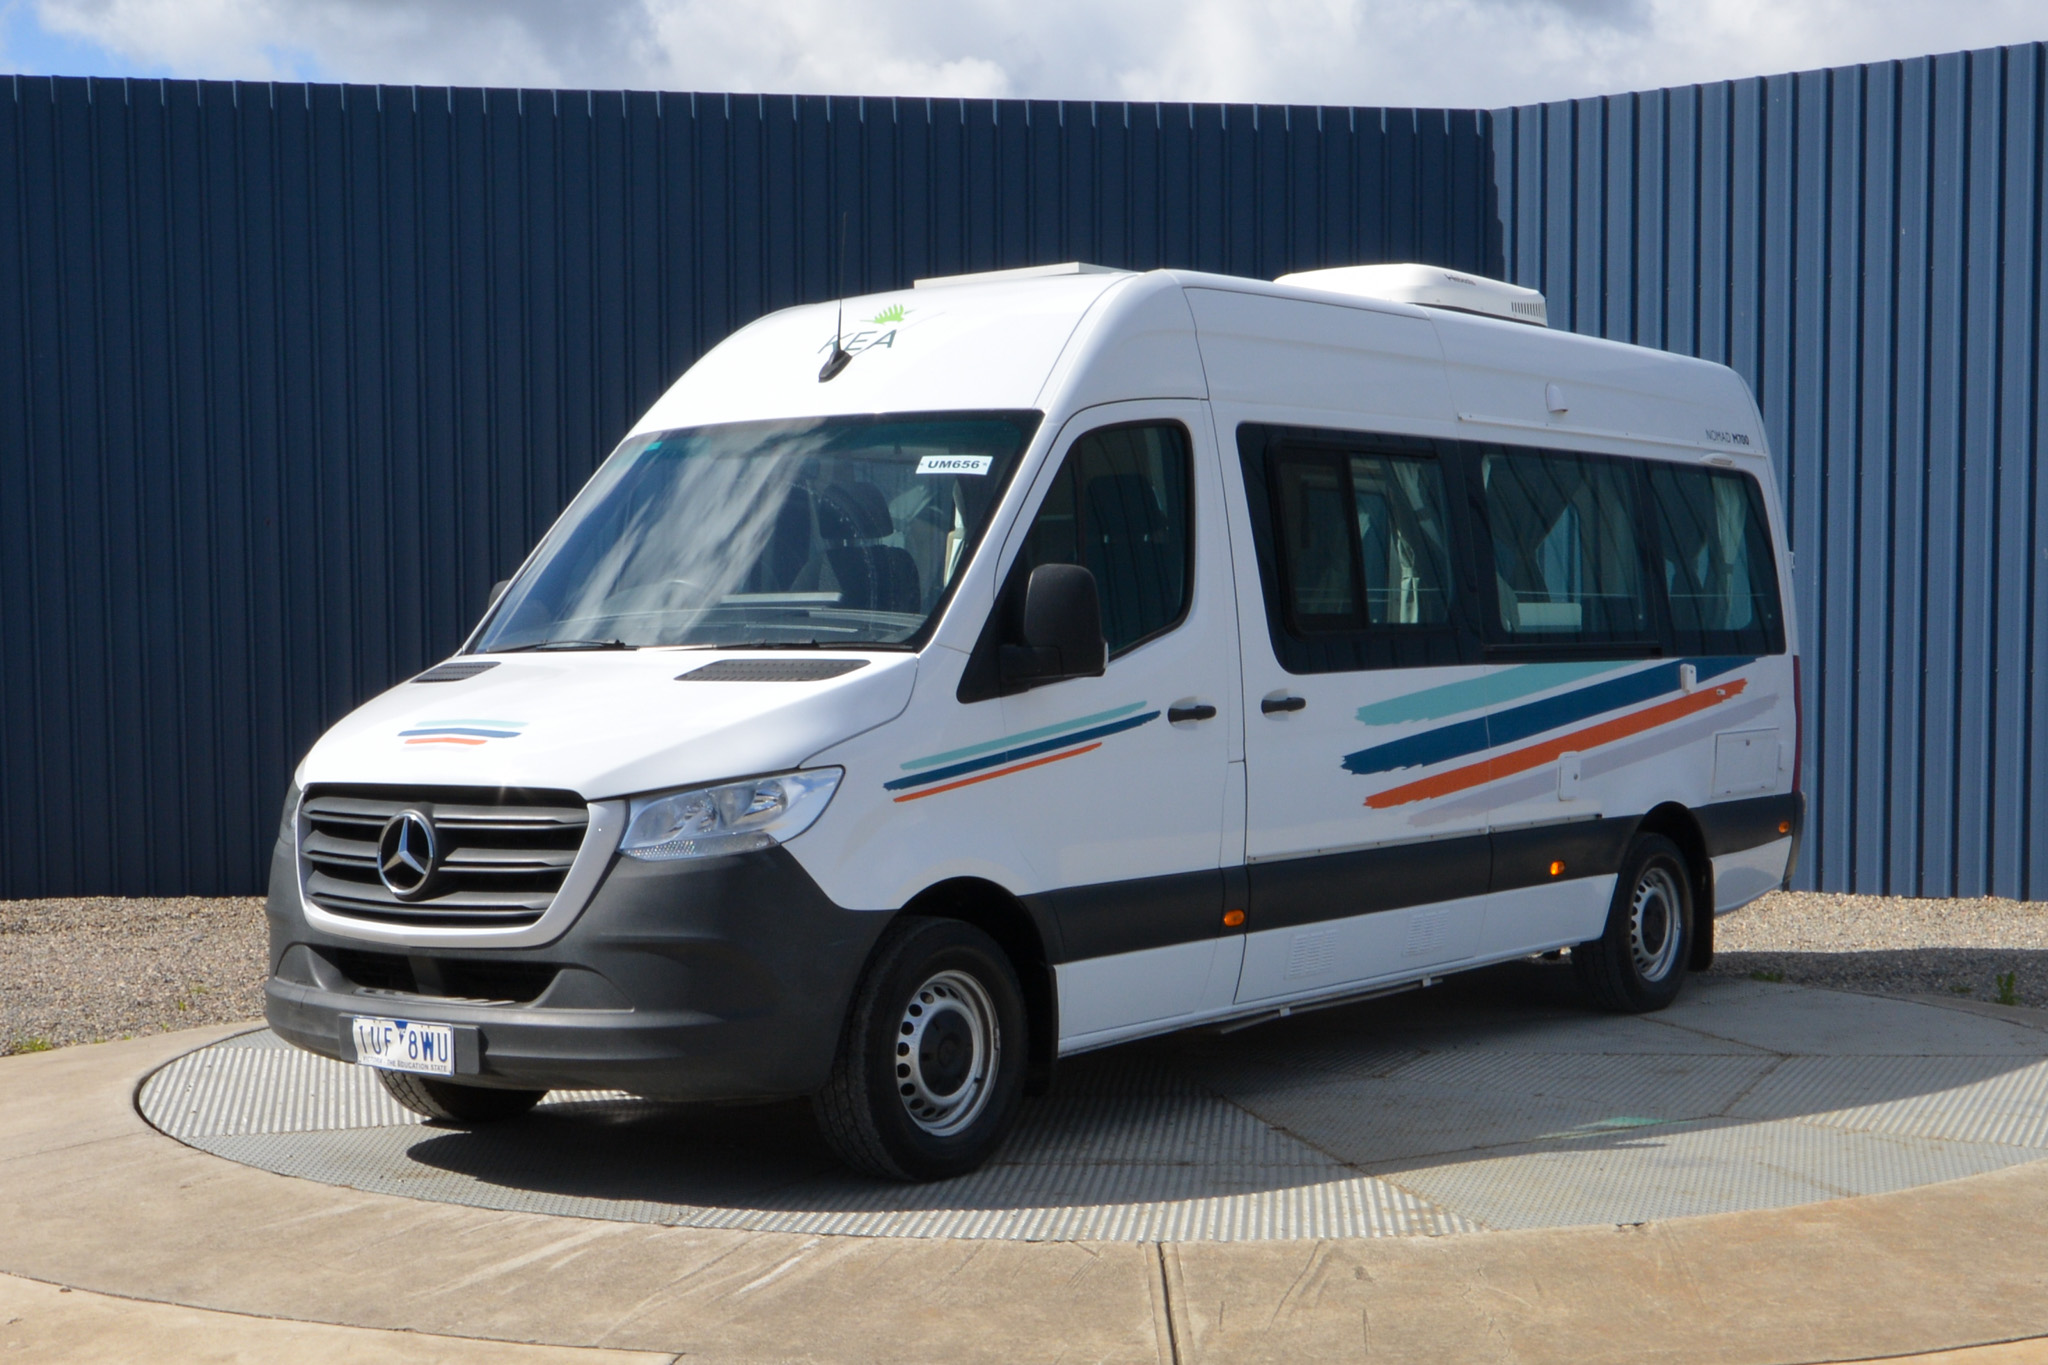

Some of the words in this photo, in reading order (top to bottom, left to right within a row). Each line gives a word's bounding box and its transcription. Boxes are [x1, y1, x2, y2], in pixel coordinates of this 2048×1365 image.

[927, 460, 980, 469] UM656
[359, 1025, 392, 1056] 1UF
[408, 1030, 448, 1062] 8WU
[397, 1060, 429, 1071] EDUCATION
[430, 1064, 447, 1072] STATE
